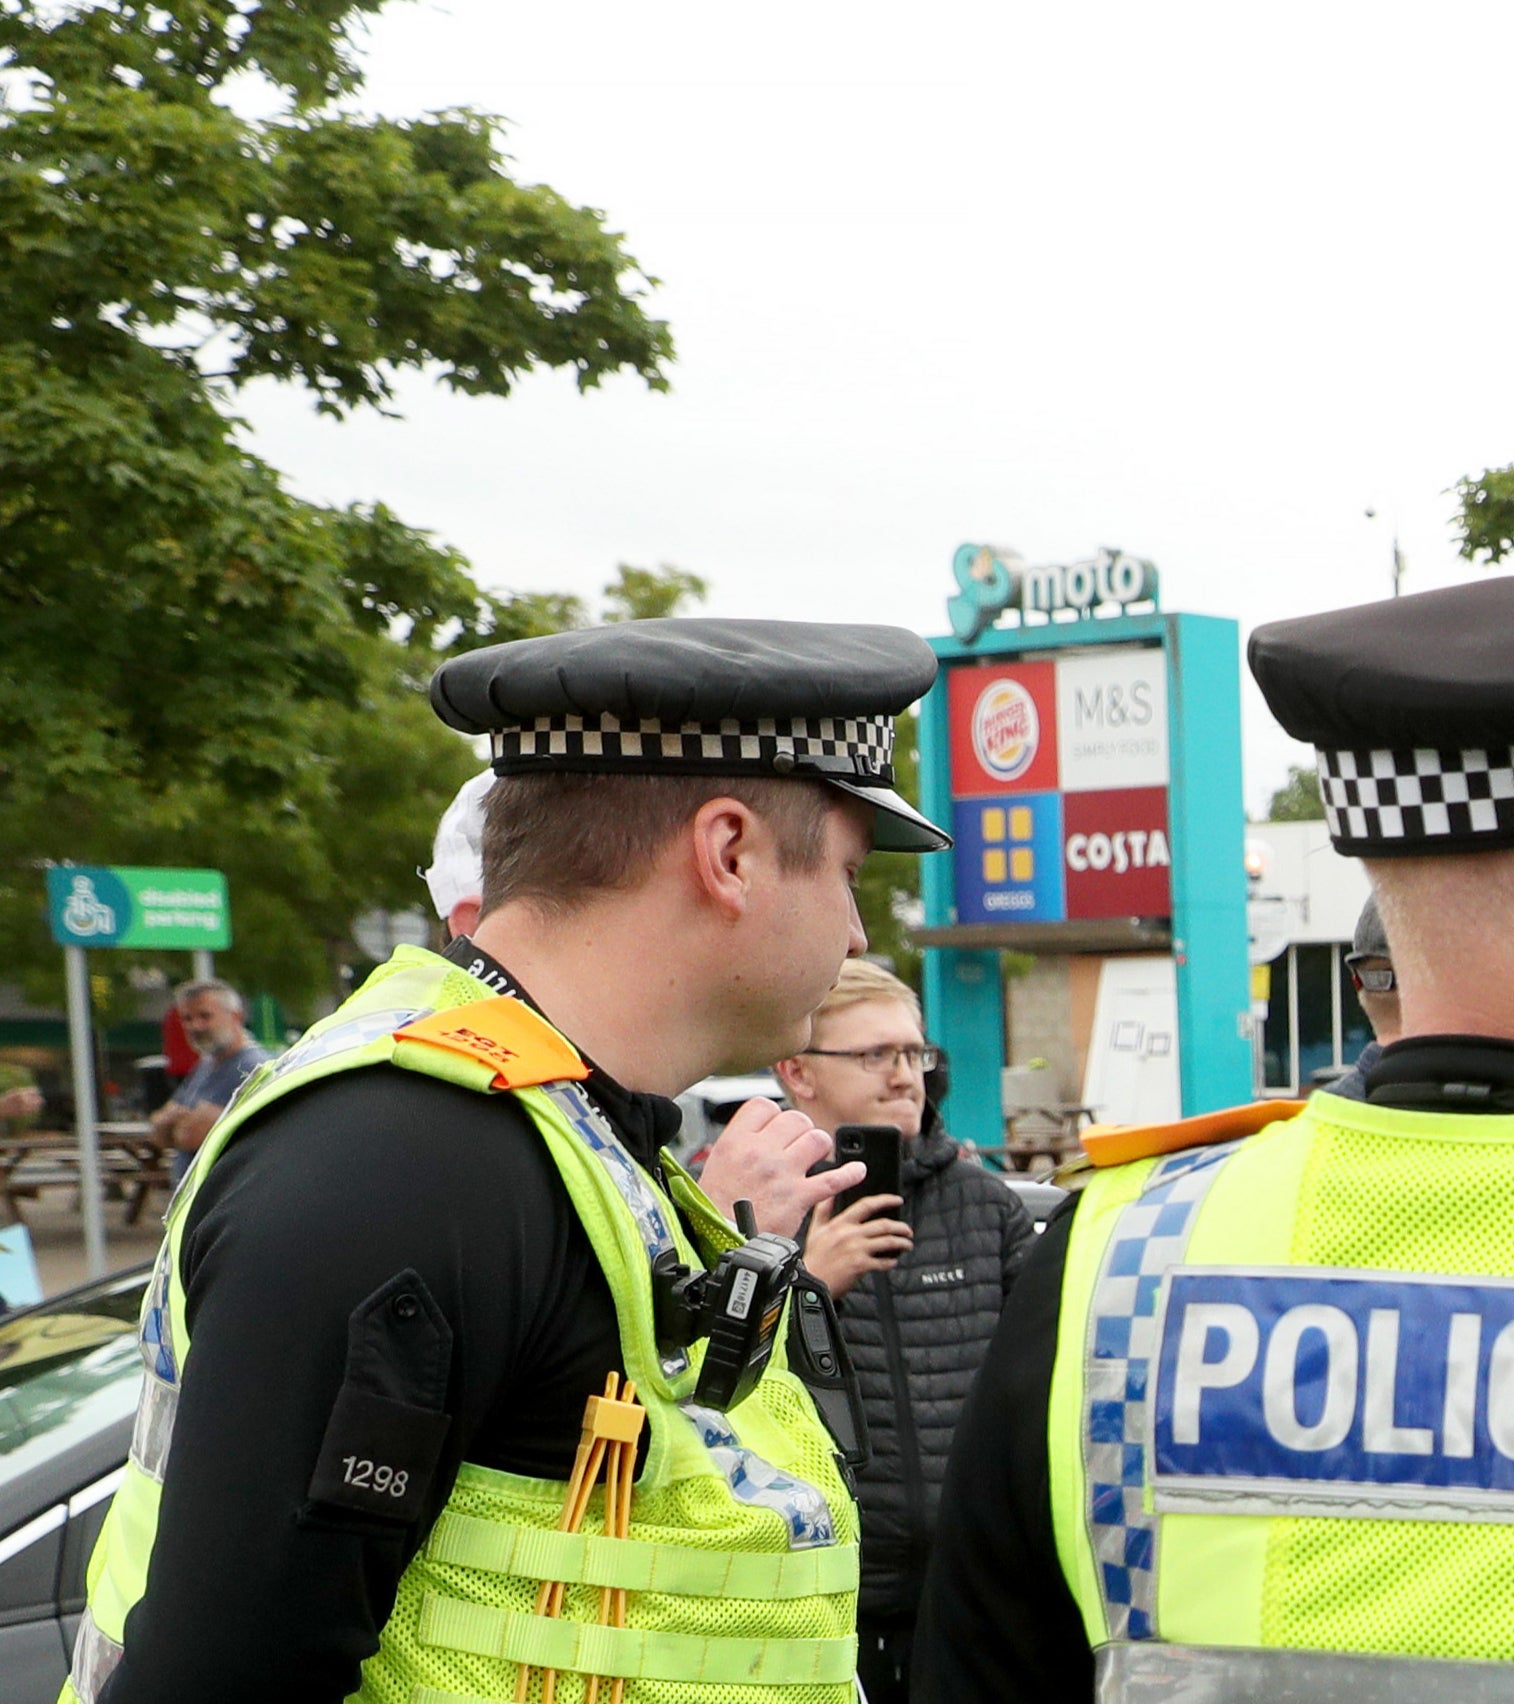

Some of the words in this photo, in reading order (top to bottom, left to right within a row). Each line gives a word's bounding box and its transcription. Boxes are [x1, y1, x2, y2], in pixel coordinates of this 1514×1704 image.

[1023, 548, 1144, 610] moto
[1074, 680, 1152, 728] M&S
[986, 720, 1029, 750] KING
[1066, 829, 1170, 873] COSTA
[342, 1456, 409, 1497] 1298
